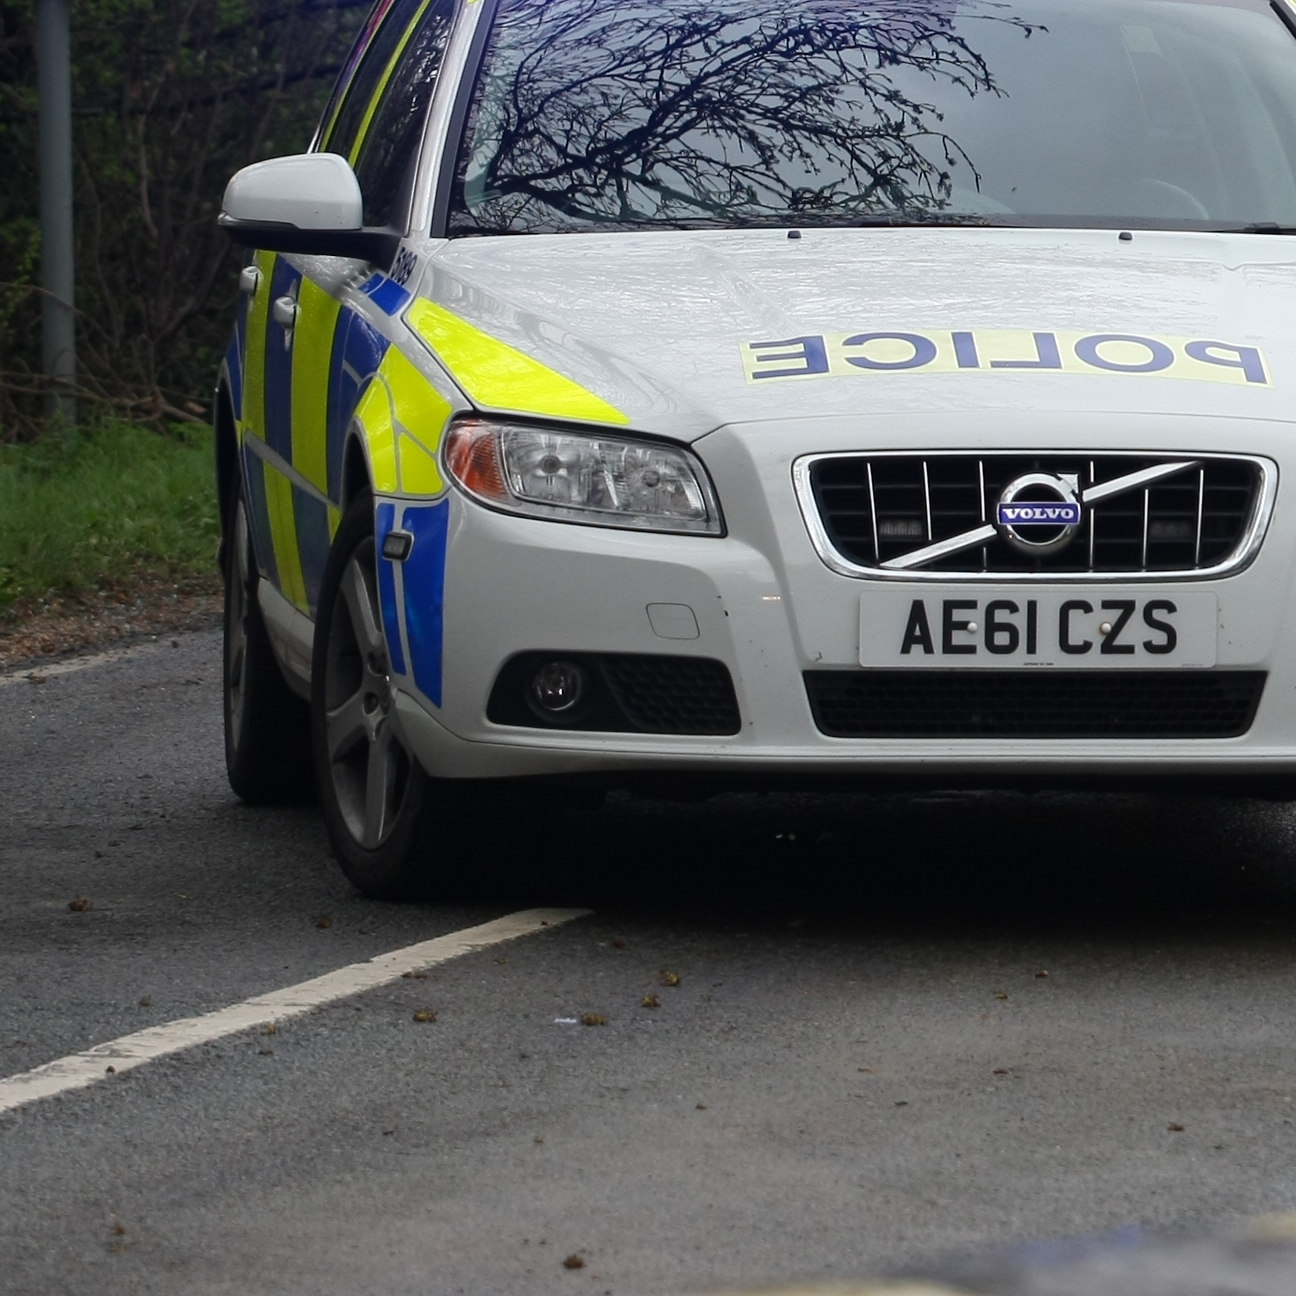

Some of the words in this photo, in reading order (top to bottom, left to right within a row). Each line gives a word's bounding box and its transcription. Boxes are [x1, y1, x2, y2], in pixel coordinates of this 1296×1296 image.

[1002, 507, 1075, 520] VOLVO
[901, 599, 1037, 655] AE61
[1058, 599, 1178, 655] CZS
